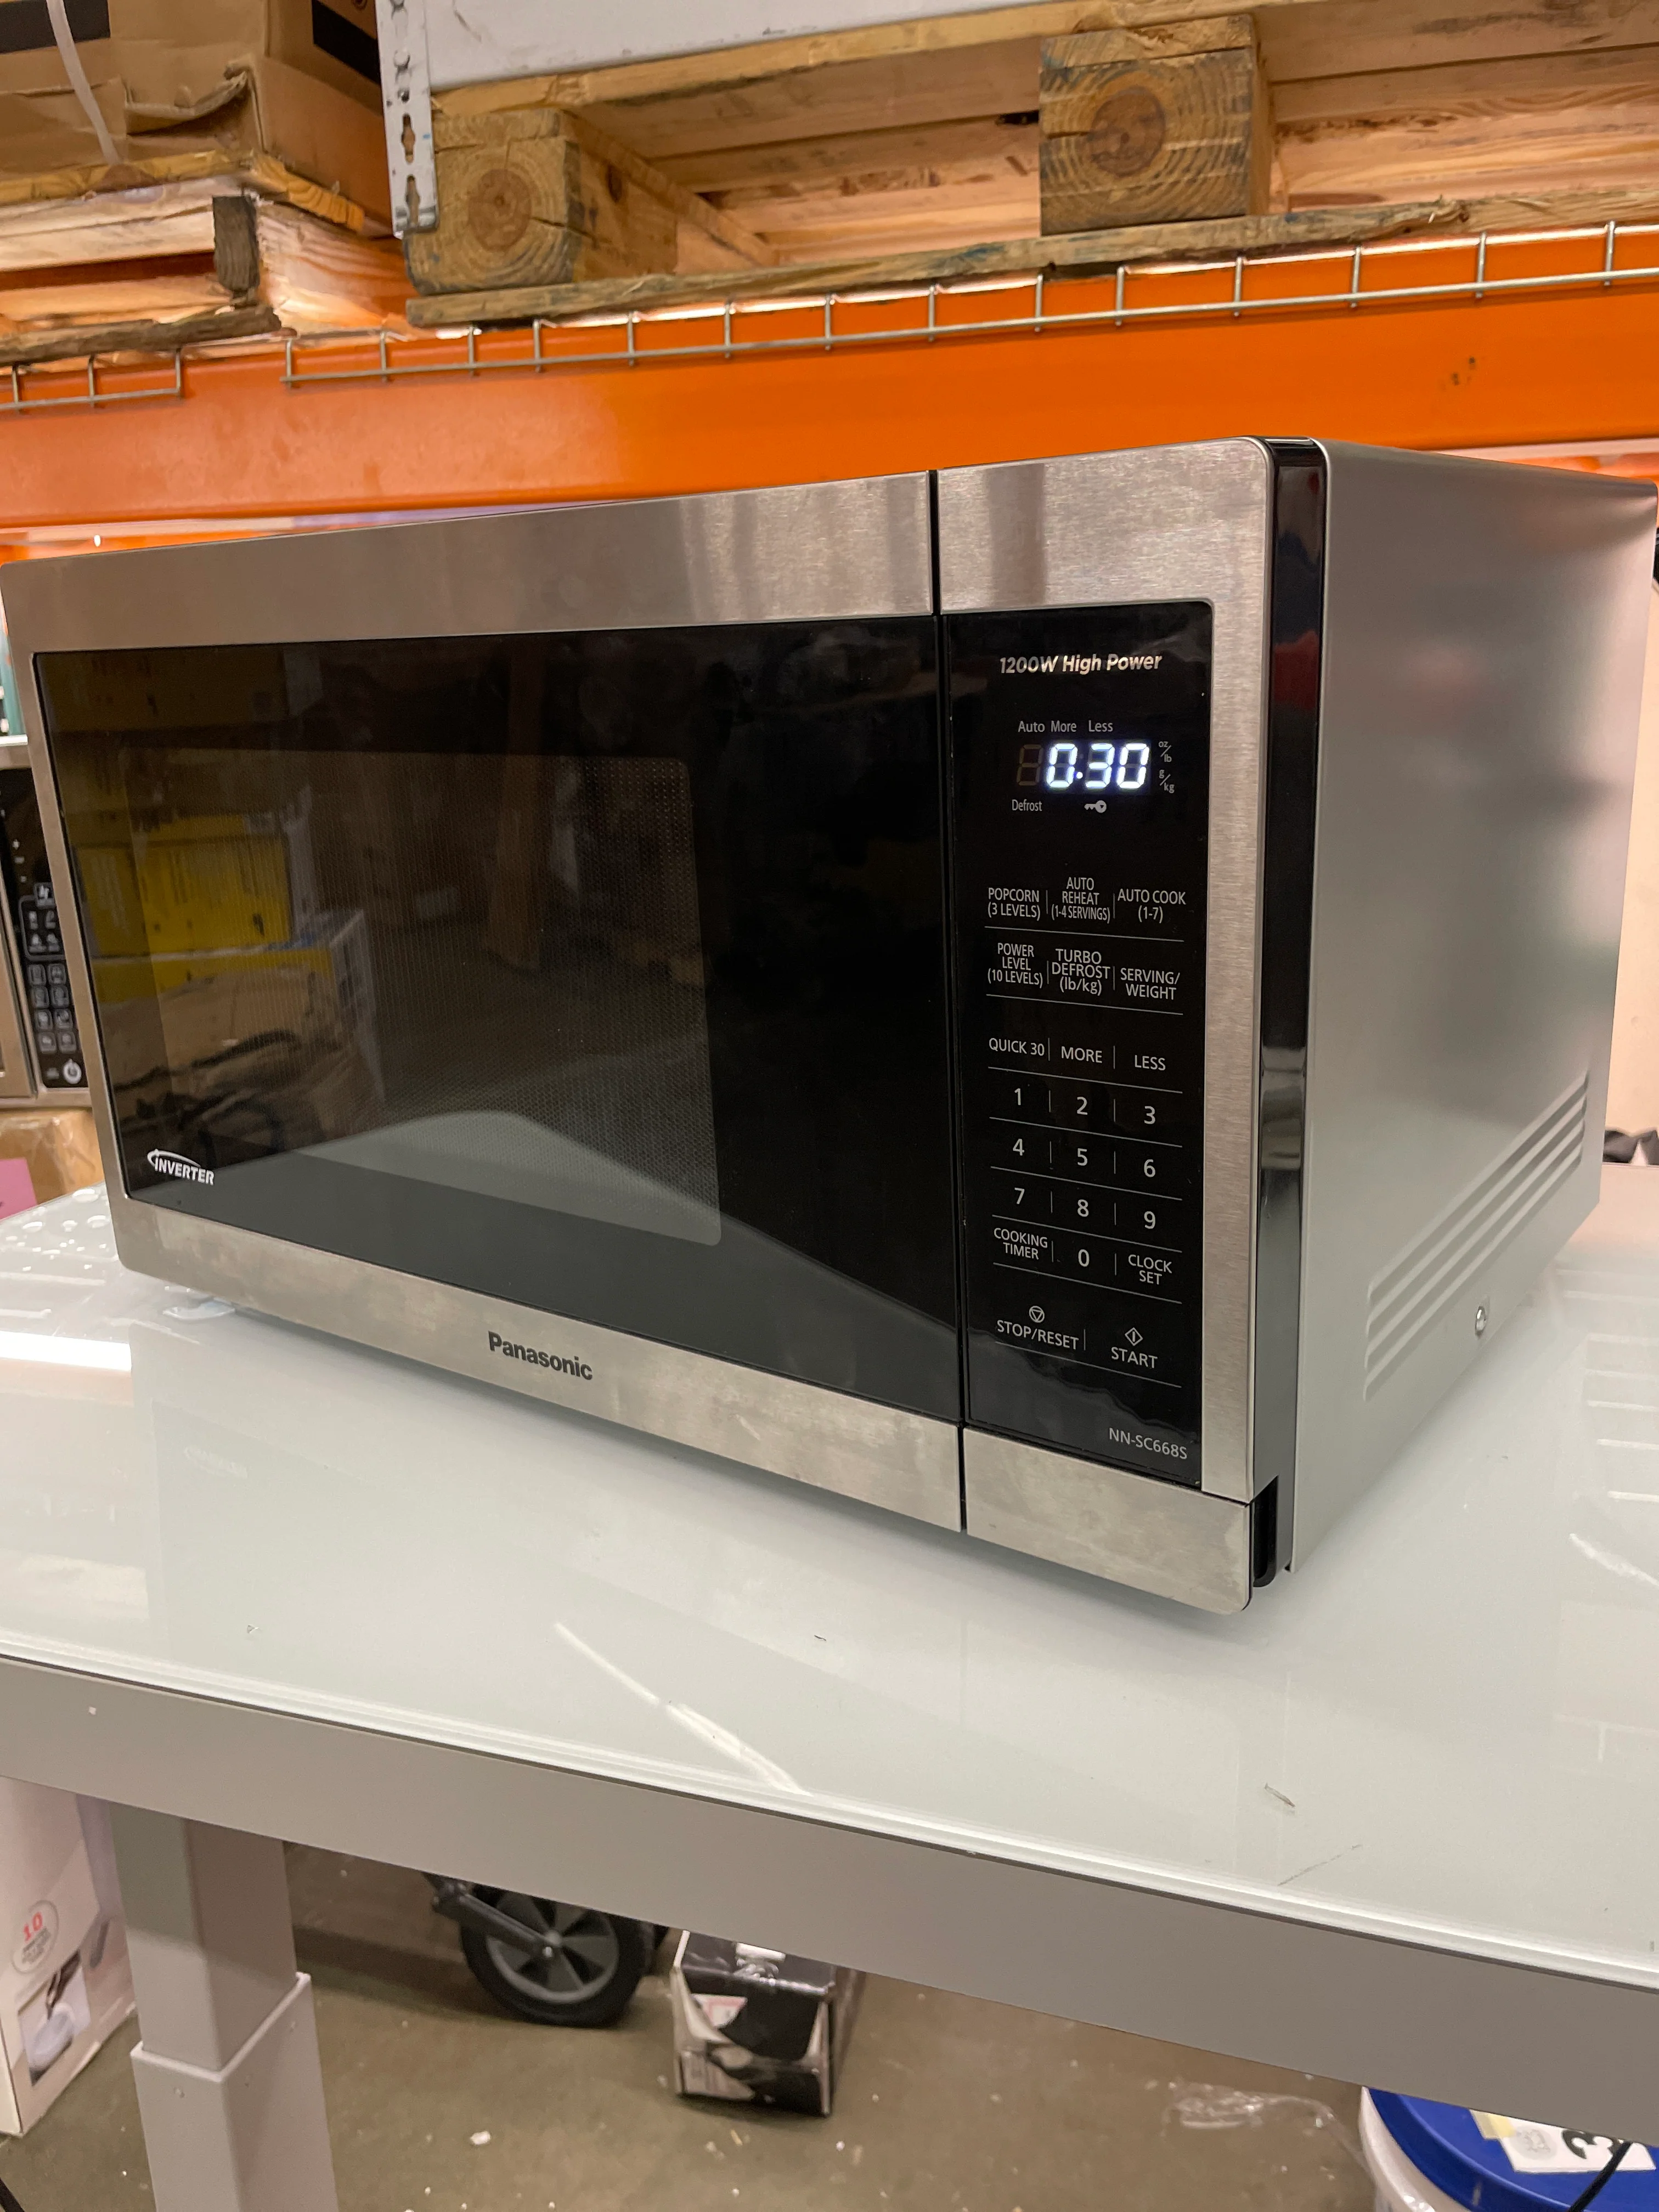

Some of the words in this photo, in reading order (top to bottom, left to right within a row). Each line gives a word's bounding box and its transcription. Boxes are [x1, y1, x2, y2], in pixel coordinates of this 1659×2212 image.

[1000, 655, 1059, 673] 1200W
[1062, 654, 1102, 675] High
[1106, 654, 1162, 671] Power
[1018, 720, 1045, 733] Auto
[1051, 720, 1077, 732] More
[1088, 720, 1113, 732] Less
[1012, 798, 1042, 811] Defrost
[1066, 877, 1094, 891] AUTO
[988, 887, 1040, 902] POPCORN
[1062, 890, 1100, 905] REHEAT
[1117, 888, 1150, 903] AUTO
[1152, 890, 1186, 905] COOK
[988, 901, 998, 918] (3
[1001, 903, 1041, 921] LEVELS)
[1051, 904, 1067, 921] (1-4
[1068, 905, 1110, 924] SERVINGS)
[1138, 905, 1163, 924] (1-7)
[997, 942, 1035, 957] POWER
[1055, 948, 1102, 964] TURBO
[1002, 956, 1031, 971] LEVEL
[1052, 962, 1111, 979] DEFROST
[988, 968, 1003, 984] (10
[1005, 970, 1043, 989] LEVELS)
[1120, 967, 1181, 985] SERVING/
[1059, 976, 1102, 996] (lb/kg)
[1125, 983, 1177, 1000] WEIGHT
[989, 1037, 1028, 1054] QUICK
[1030, 1042, 1045, 1056] 30
[1061, 1046, 1102, 1063] MORE
[1135, 1054, 1166, 1071] LESS
[1014, 1088, 1022, 1105] 1
[1076, 1096, 1088, 1115] 2
[1144, 1105, 1156, 1125] 3
[1012, 1138, 1025, 1156] 4
[1077, 1148, 1088, 1166] 5
[153, 1149, 215, 1186] INVERTER
[1143, 1159, 1156, 1178] 6
[1014, 1187, 1025, 1205] 7
[1077, 1199, 1089, 1217] 8
[1144, 1211, 1156, 1229] 9
[994, 1227, 1048, 1249] COOKING
[1003, 1242, 1039, 1260] TIMER
[1078, 1249, 1090, 1267] 0
[1128, 1254, 1172, 1274] CLOCK
[1139, 1268, 1163, 1285] SET
[996, 1319, 1079, 1350] STOP/RESET
[488, 1330, 593, 1380] Panasonic
[1111, 1346, 1158, 1369] START
[1109, 1427, 1187, 1460] NN-SC668S
